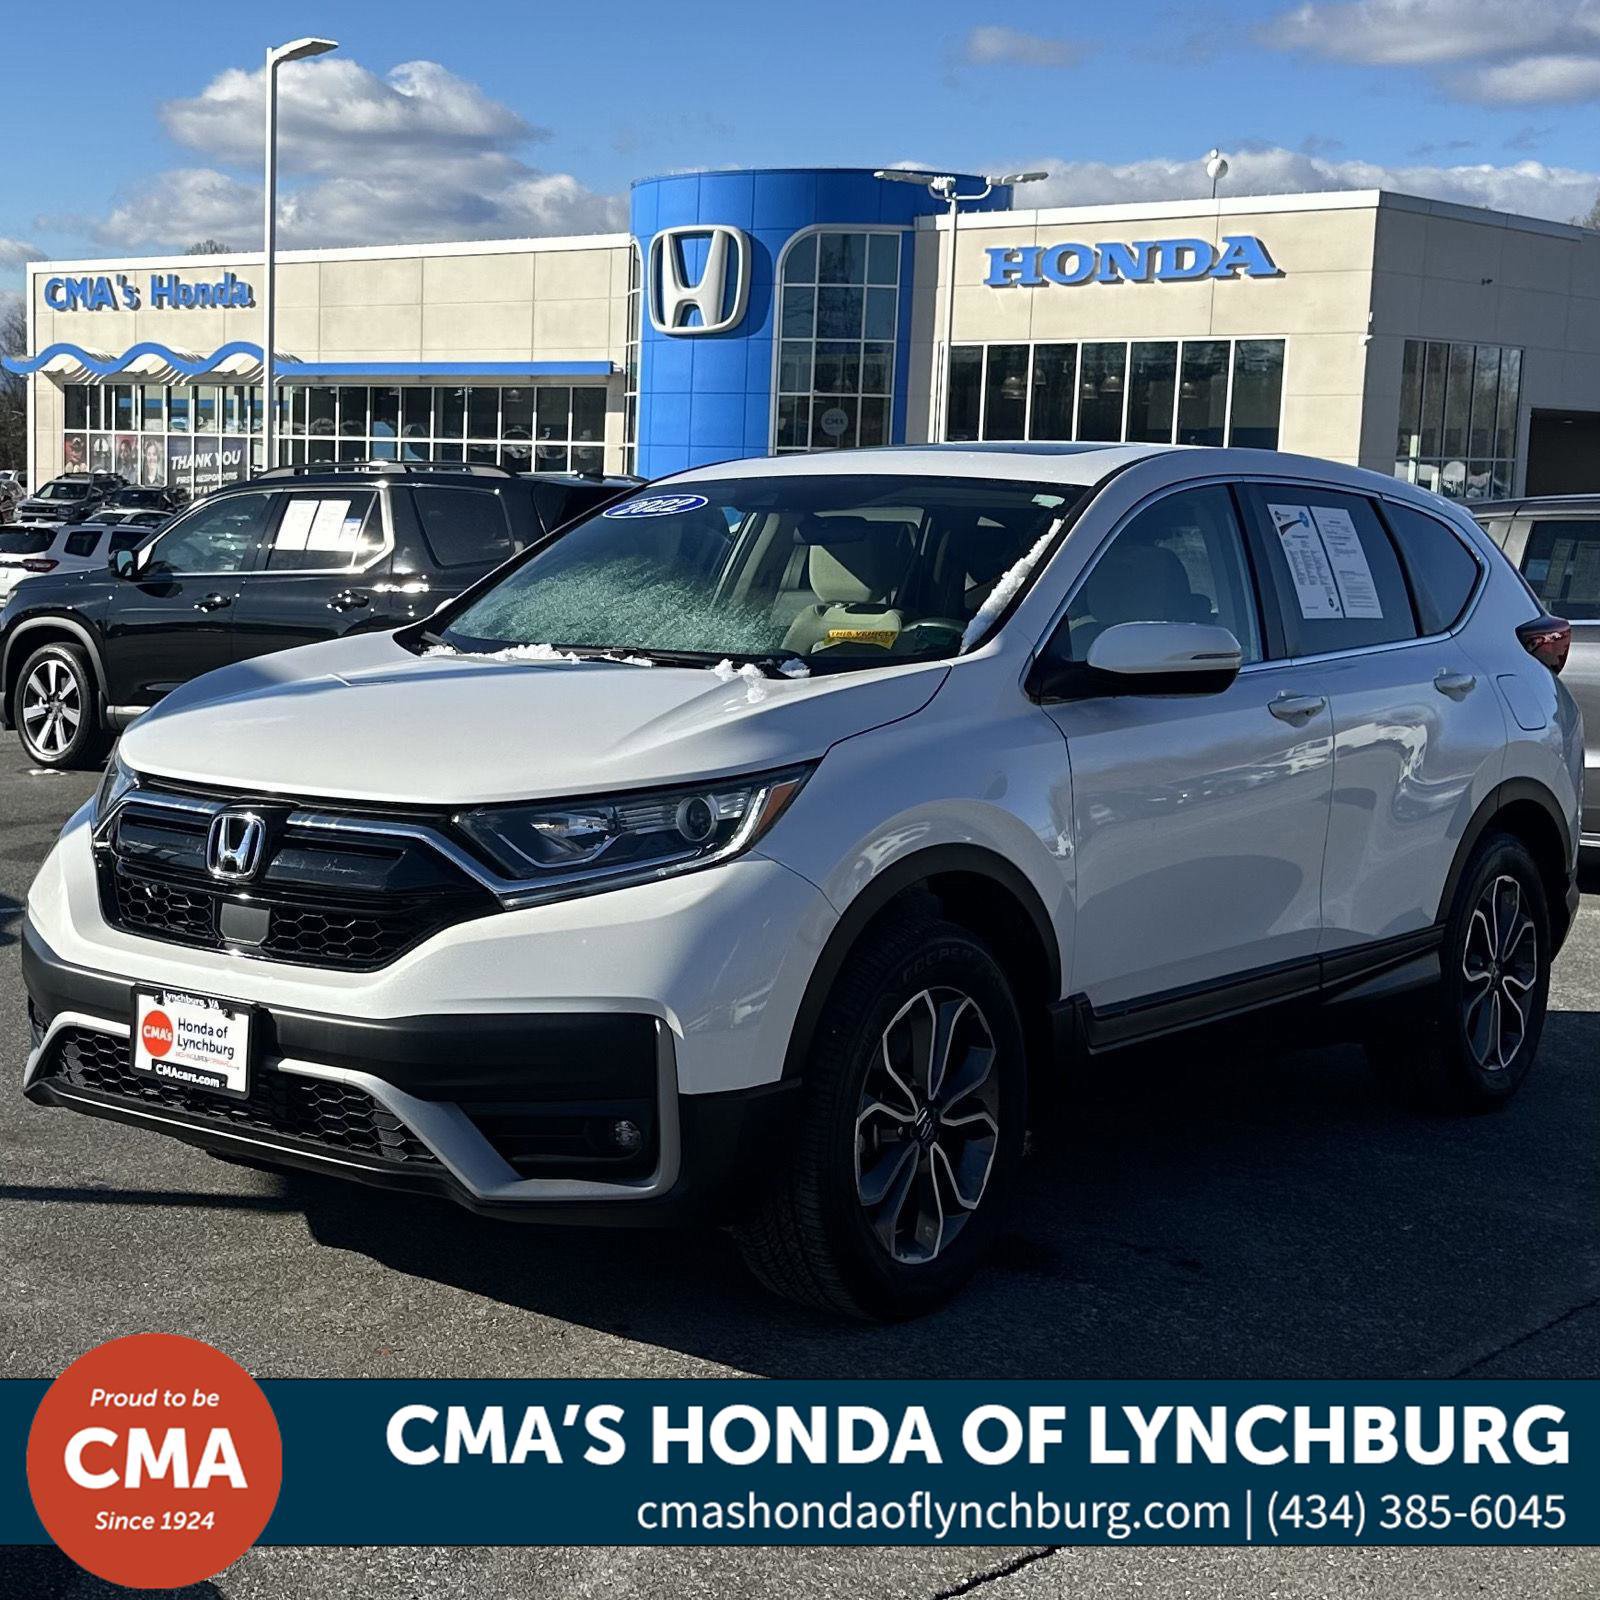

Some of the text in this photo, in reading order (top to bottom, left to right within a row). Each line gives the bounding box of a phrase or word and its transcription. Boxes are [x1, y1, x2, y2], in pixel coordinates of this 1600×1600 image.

[983, 235, 1282, 288] HONDA
[44, 271, 253, 311] CMA's Honda
[171, 450, 241, 470] THANK YOU
[143, 1024, 173, 1042] CMA's
[177, 1017, 228, 1039] Honda of
[177, 1034, 235, 1061] Lynchburg
[155, 1063, 220, 1088] CMAcars.com
